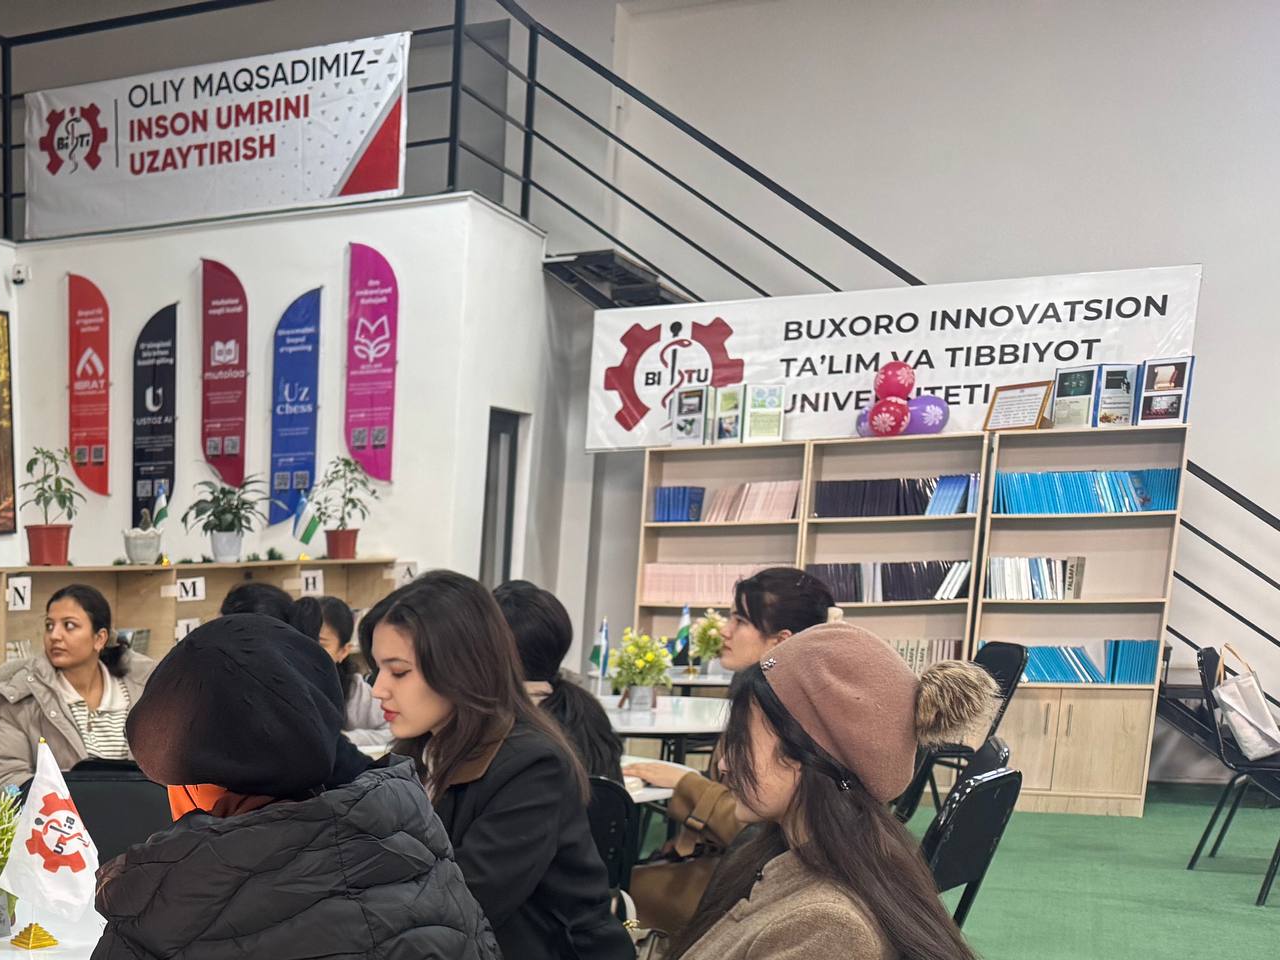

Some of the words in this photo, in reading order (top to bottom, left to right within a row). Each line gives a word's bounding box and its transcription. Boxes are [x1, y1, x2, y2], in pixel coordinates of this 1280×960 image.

[128, 78, 185, 110] OLIY
[129, 108, 209, 142] INSON
[216, 94, 310, 131] UMRINI
[129, 134, 276, 176] UZAYTIRISH
[784, 311, 919, 342] BUXORO
[929, 293, 1168, 331] INNOVATSION
[945, 338, 1101, 368] TIBBIYOT
[276, 403, 313, 416] Chess
[304, 576, 317, 591] H
[402, 566, 415, 579] A
[12, 585, 27, 606] N
[179, 580, 197, 598] M
